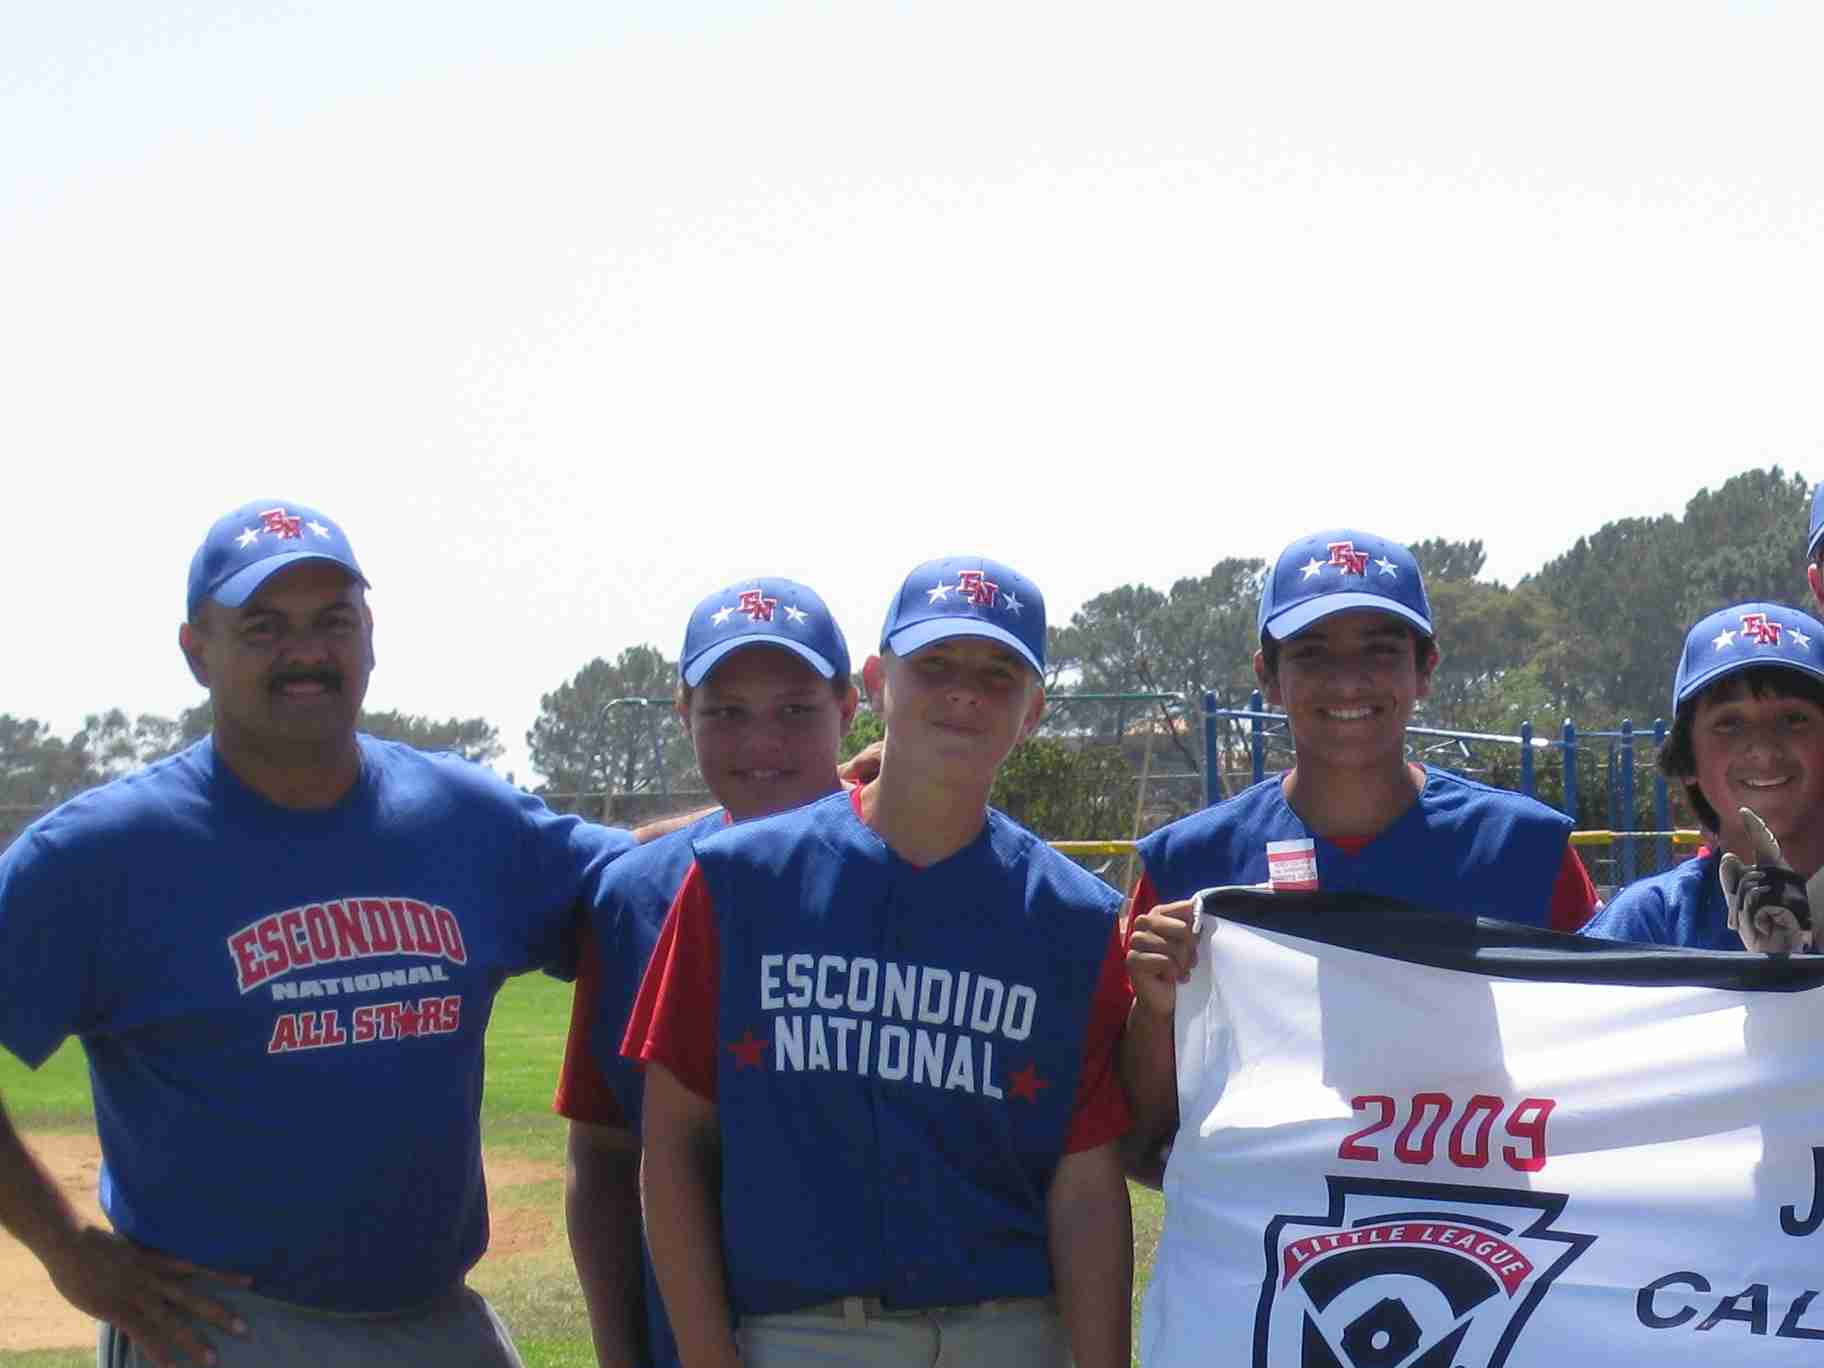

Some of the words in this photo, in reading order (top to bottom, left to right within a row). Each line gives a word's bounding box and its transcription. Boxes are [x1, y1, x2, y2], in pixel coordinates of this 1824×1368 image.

[227, 896, 467, 994] ESCONDIDO
[271, 964, 449, 1001] NATIONAL
[267, 1010, 346, 1054] ALL
[760, 953, 1038, 1041] ESCONDIDO
[773, 1014, 1004, 1100] NATIONAL
[1337, 1092, 1558, 1173] 2009
[1291, 1226, 1405, 1262] LITTLE
[1420, 1225, 1525, 1276] LEAGUE
